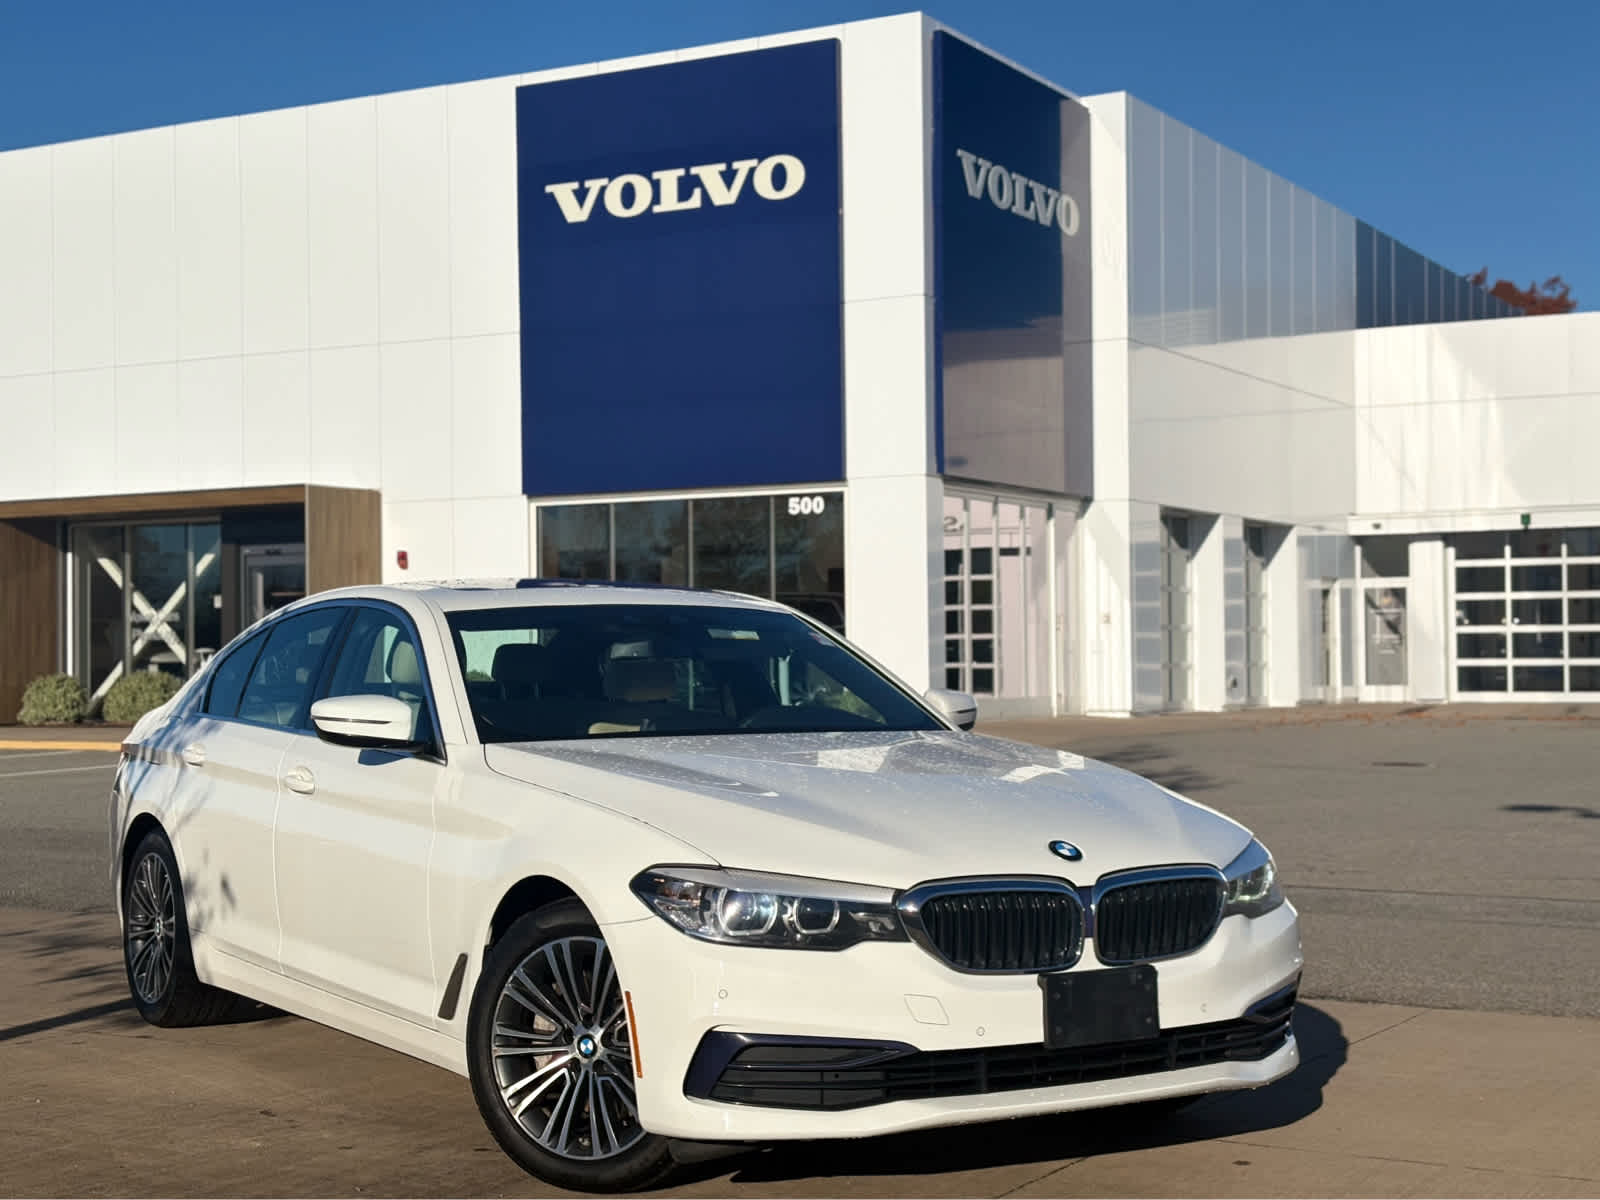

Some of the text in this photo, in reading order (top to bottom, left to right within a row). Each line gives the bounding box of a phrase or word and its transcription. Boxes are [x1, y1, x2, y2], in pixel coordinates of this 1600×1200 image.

[545, 154, 806, 223] VOLVO
[956, 148, 1080, 237] VOLVO
[787, 496, 825, 516] 500
